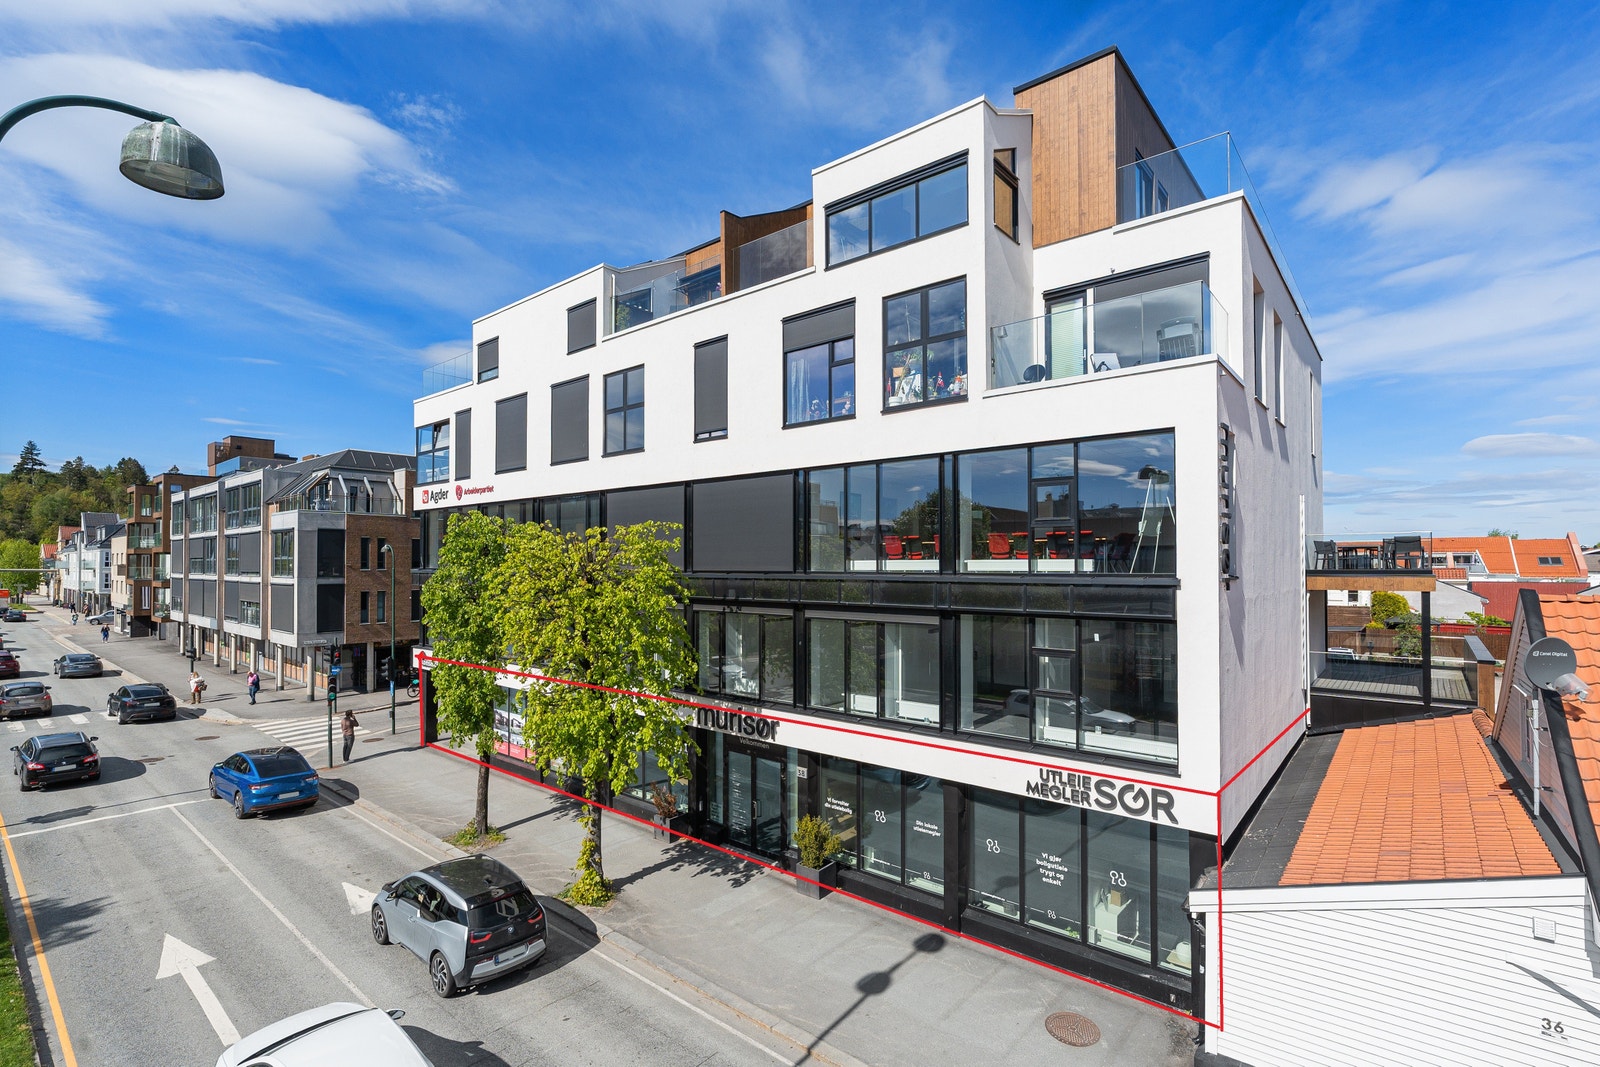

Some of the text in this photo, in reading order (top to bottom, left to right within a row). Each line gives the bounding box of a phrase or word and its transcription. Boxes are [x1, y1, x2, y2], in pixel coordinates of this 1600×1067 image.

[430, 488, 449, 504] Agder
[739, 737, 770, 750] Velkommen
[1039, 768, 1092, 791] UTLEIE
[1026, 780, 1092, 807] MEGLER
[1039, 867, 1065, 881] trygt og
[1042, 877, 1062, 887] enkelt
[1541, 1018, 1564, 1034] 36
